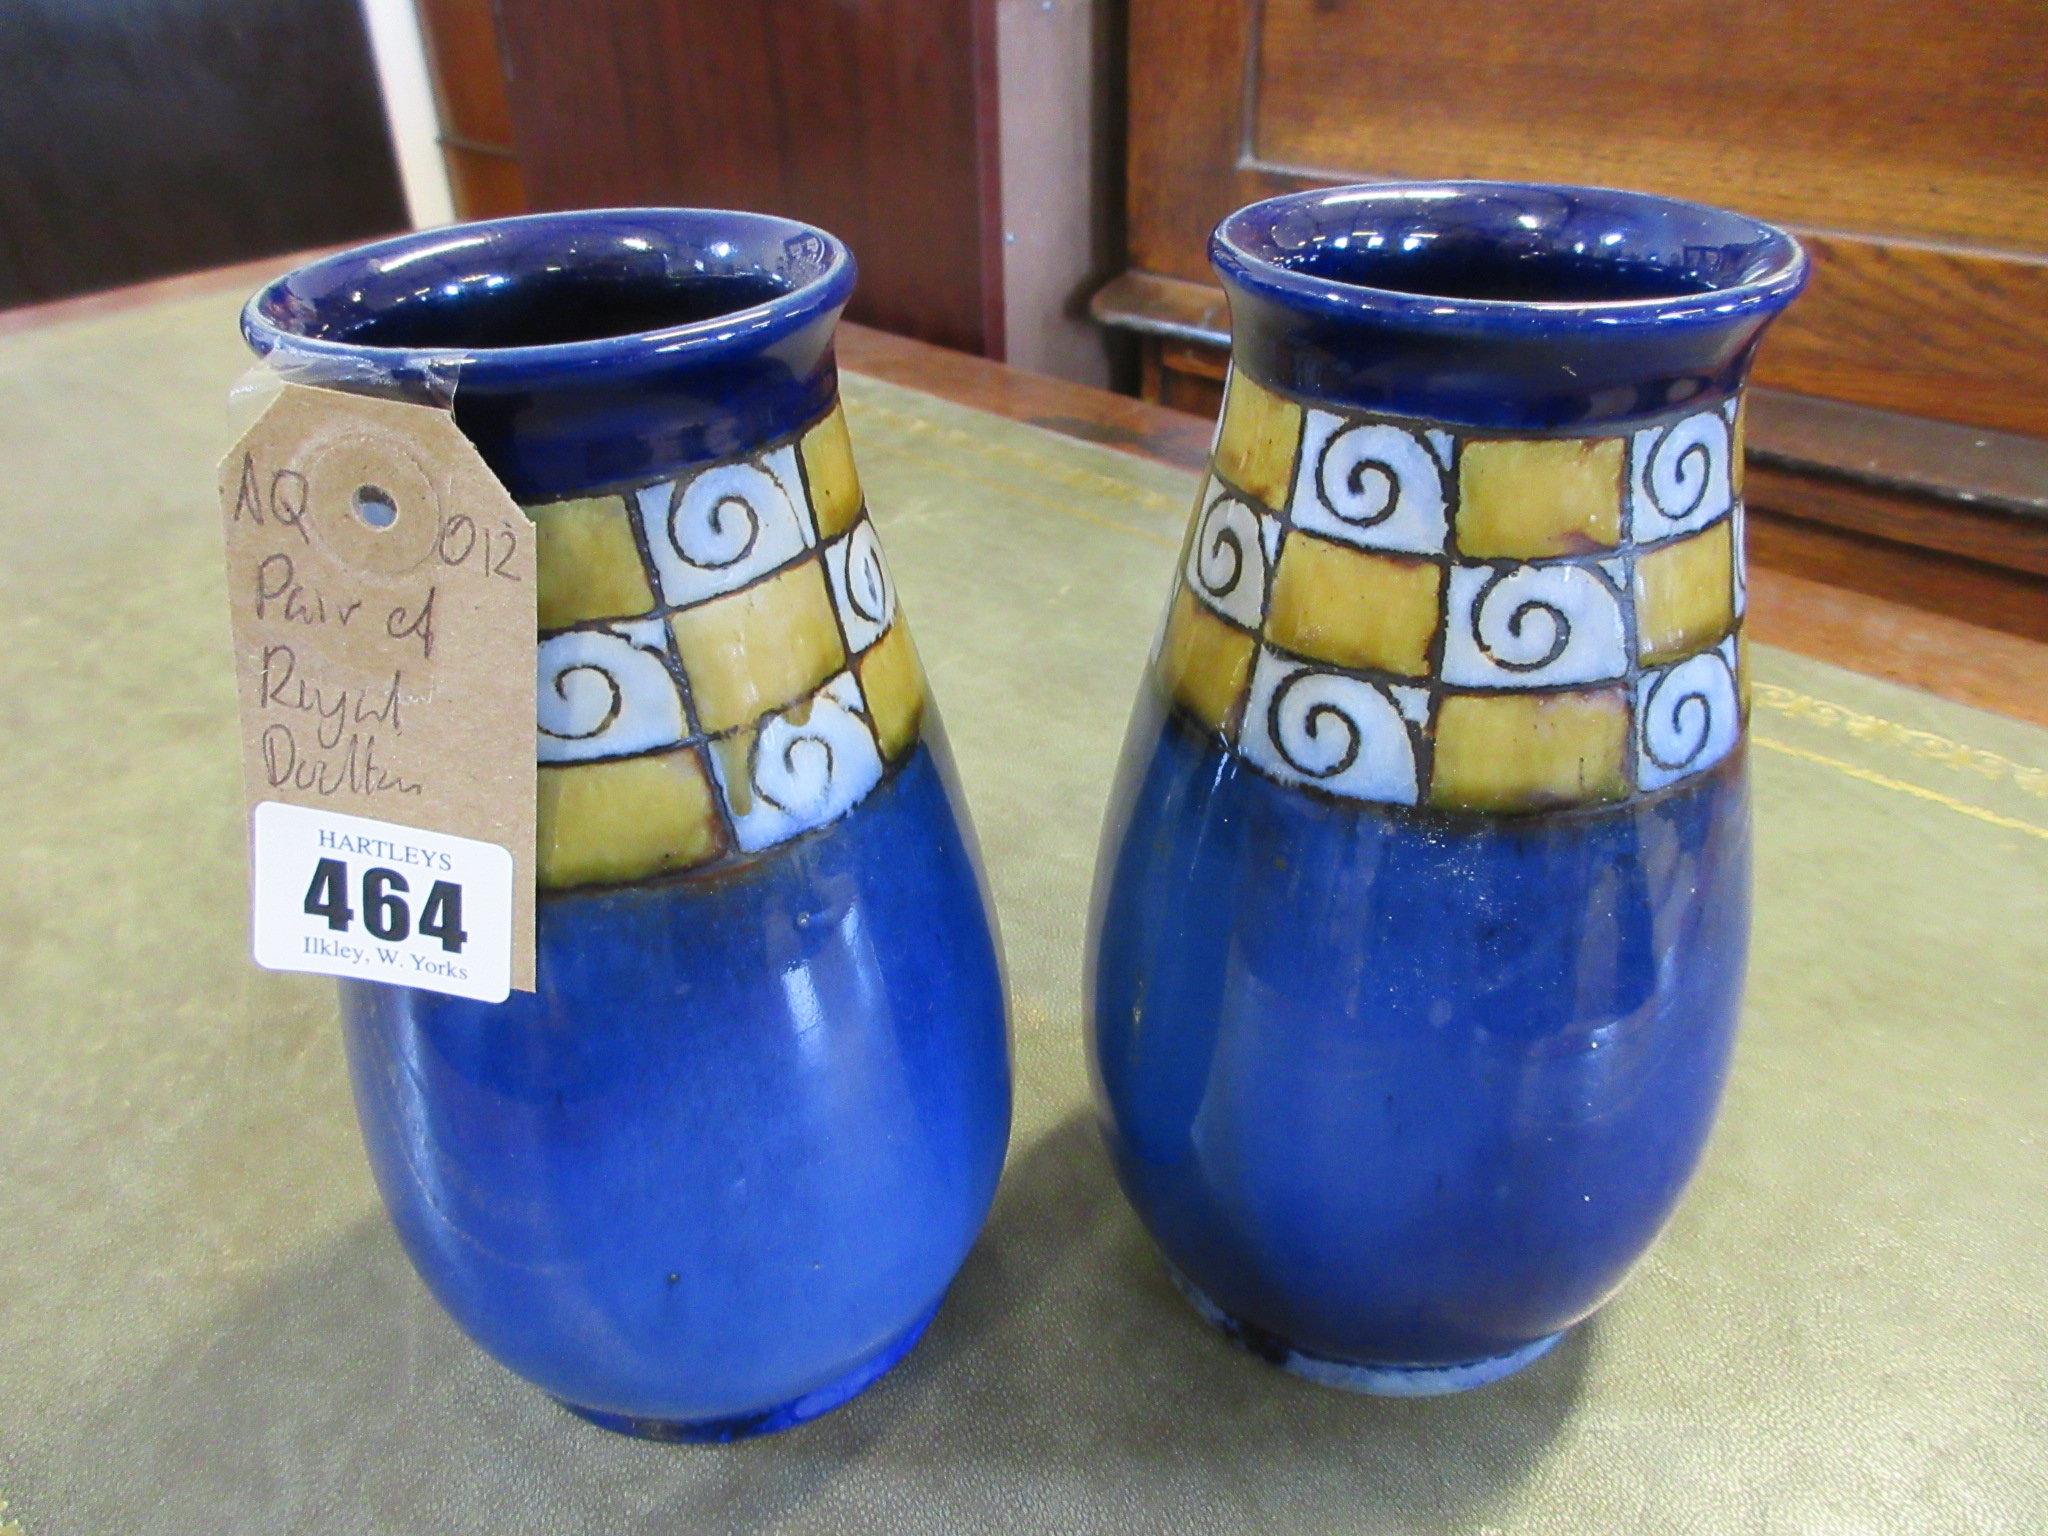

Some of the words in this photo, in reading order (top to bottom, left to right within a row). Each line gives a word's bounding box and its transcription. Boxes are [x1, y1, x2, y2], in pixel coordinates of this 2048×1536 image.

[256, 552, 362, 626] Pair
[318, 828, 453, 872] HARTLEYS
[303, 856, 469, 955] 464
[303, 935, 371, 965] Ilkley,
[376, 946, 405, 968] W.
[411, 953, 469, 982] Yorks
